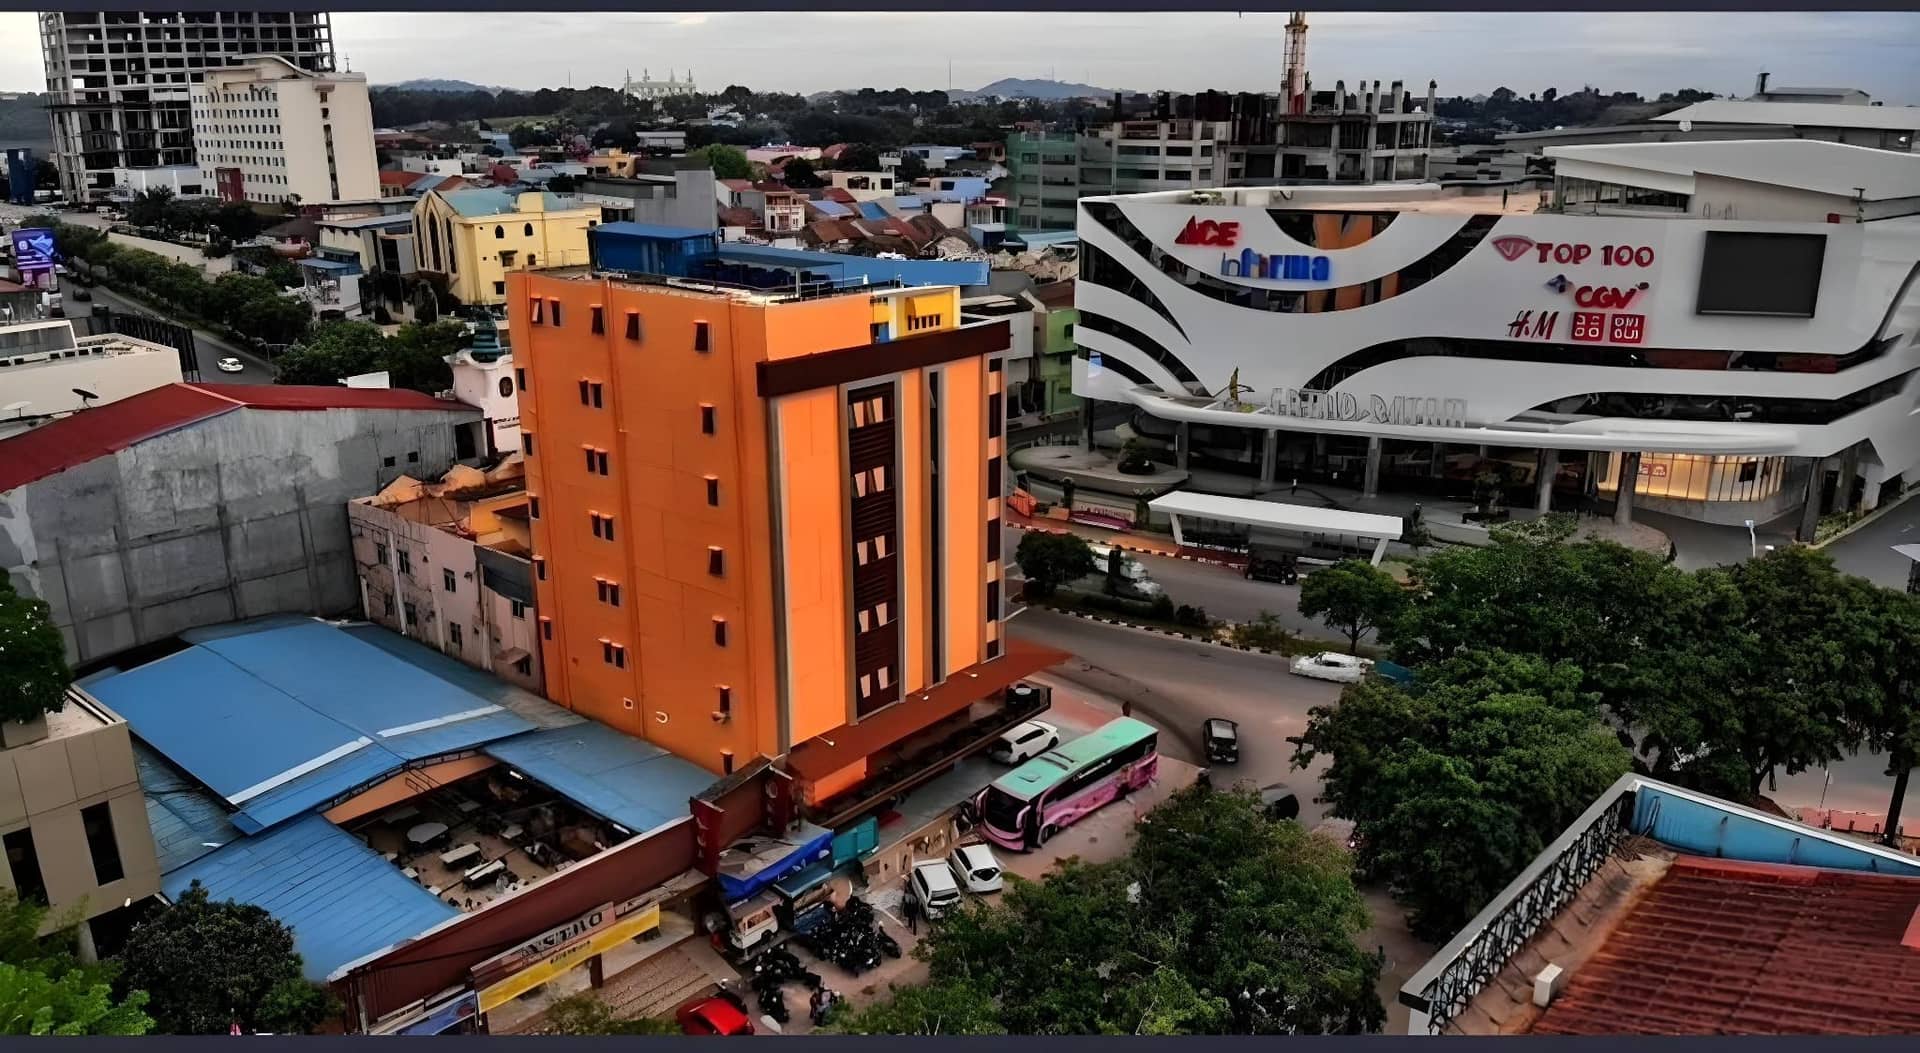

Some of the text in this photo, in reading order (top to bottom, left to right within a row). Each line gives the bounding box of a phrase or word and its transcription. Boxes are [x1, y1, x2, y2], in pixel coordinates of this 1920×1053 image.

[1175, 215, 1239, 247] ACE
[1536, 243, 1655, 268] TOP 100
[1574, 284, 1638, 309] CGV
